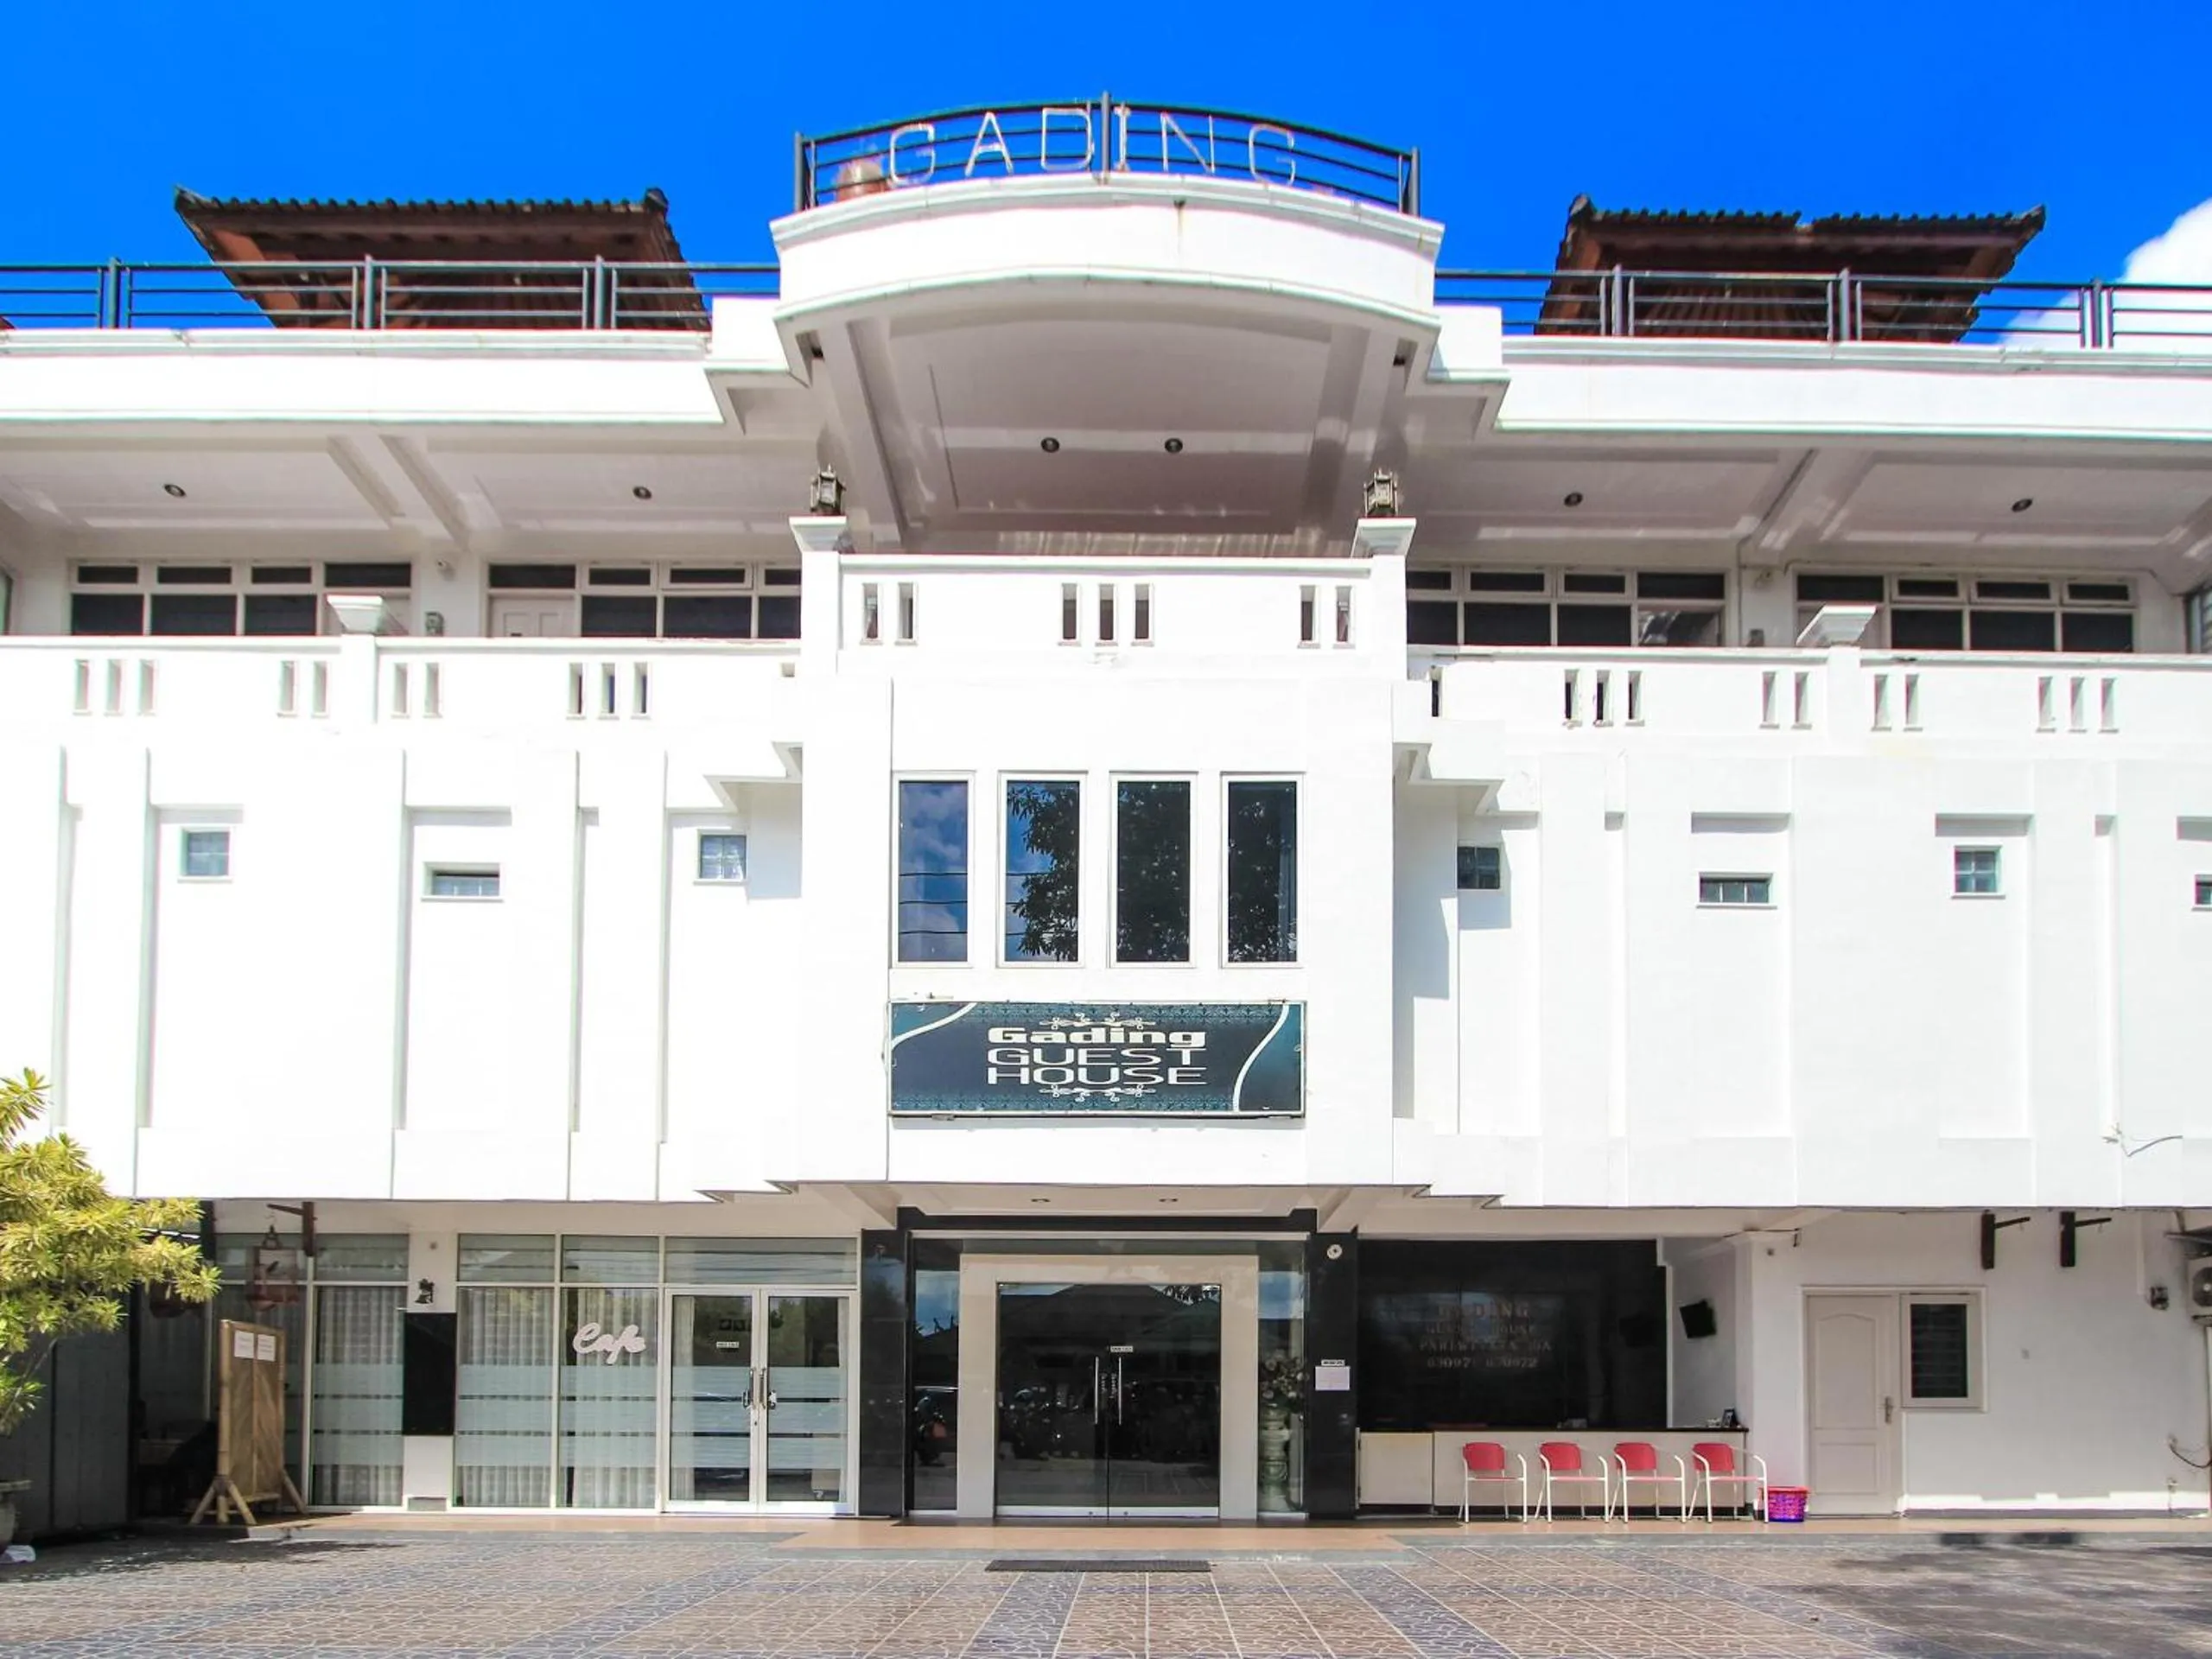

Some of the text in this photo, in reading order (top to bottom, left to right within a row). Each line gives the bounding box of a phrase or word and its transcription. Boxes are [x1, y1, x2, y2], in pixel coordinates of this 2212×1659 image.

[887, 106, 1296, 187] GADING
[988, 1027, 1206, 1048] Gading
[988, 1048, 1207, 1065] GUEST
[988, 1066, 1207, 1085] HOUSE
